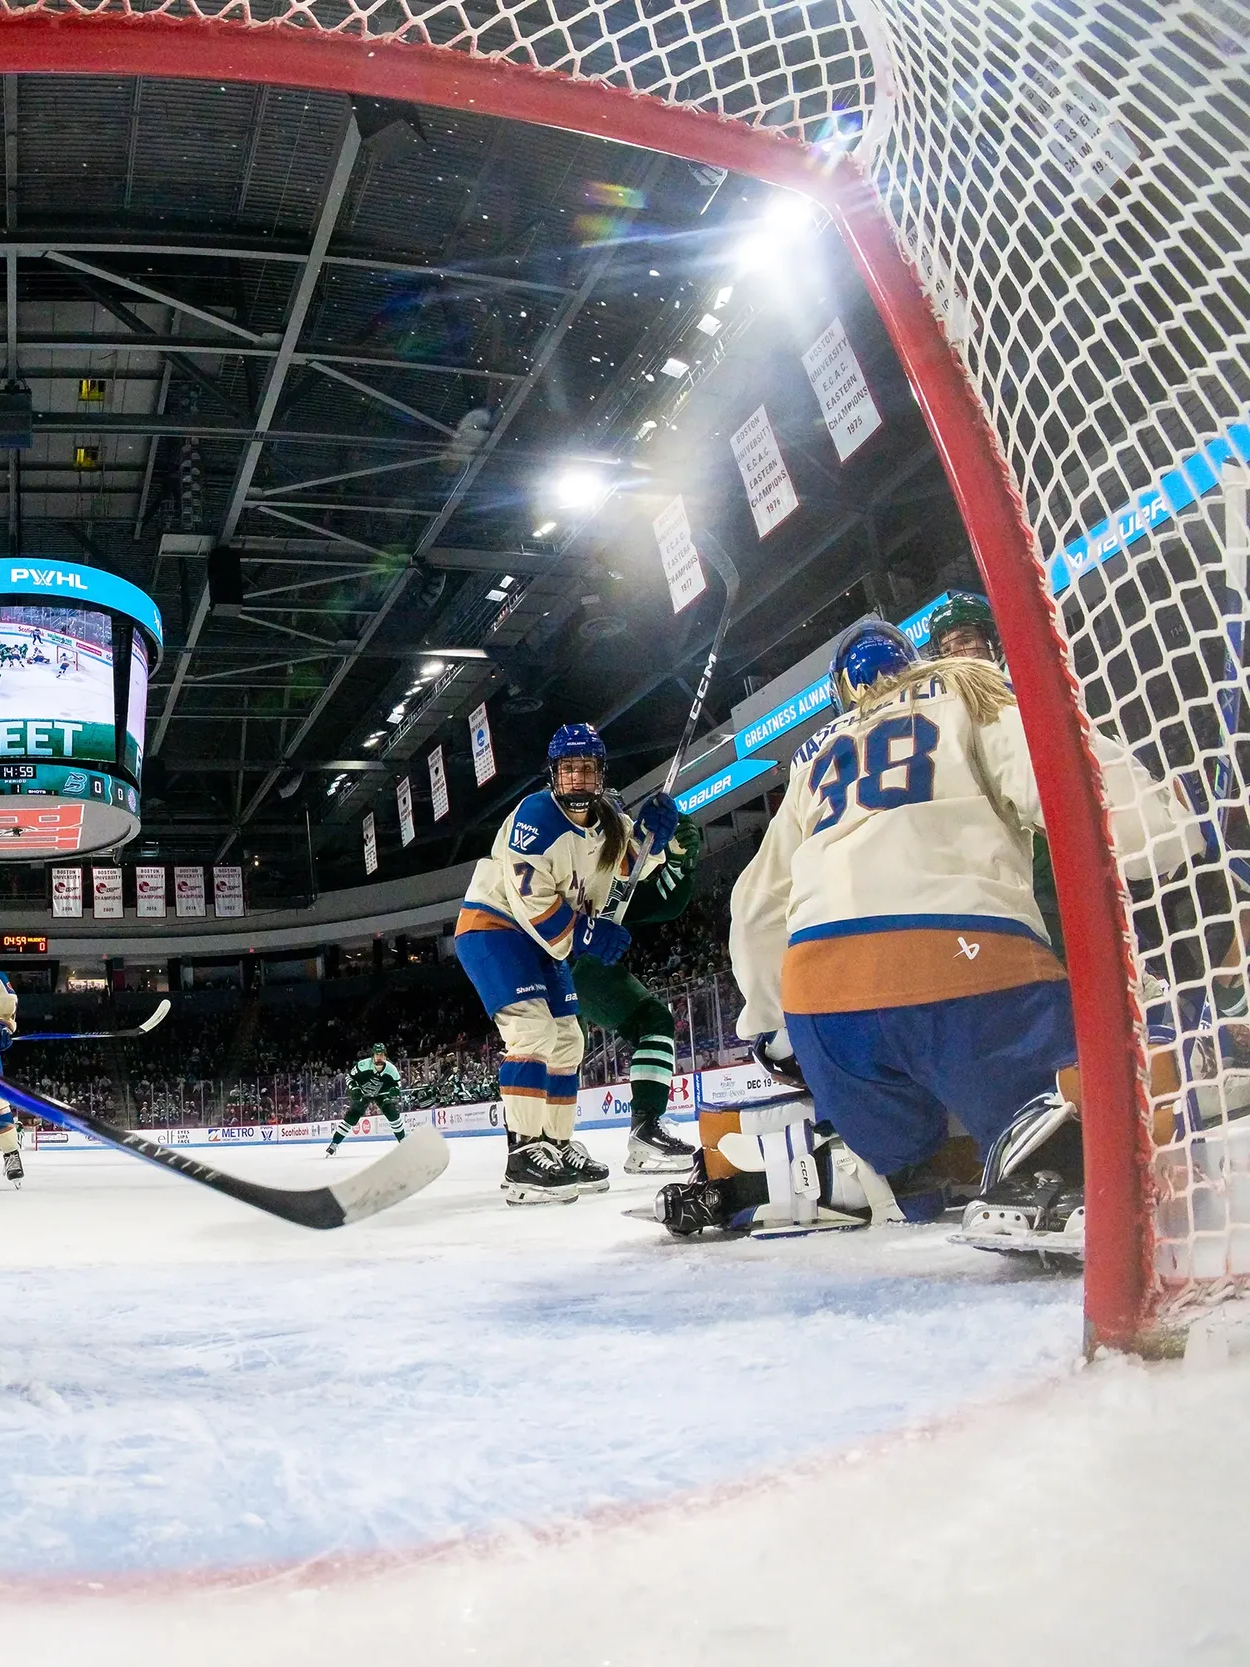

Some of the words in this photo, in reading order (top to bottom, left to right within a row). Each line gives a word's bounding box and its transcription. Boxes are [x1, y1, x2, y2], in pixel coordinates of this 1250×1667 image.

[810, 336, 849, 383] UNIVERSITY
[825, 373, 858, 411] EASTERN
[828, 385, 869, 431] CHAMPIONS
[735, 415, 760, 445] BOSTON
[846, 416, 863, 436] 1975
[736, 425, 771, 463] UNIVERSITY
[749, 458, 778, 490] EASTERN
[751, 469, 787, 508] CHAMPIONS
[11, 568, 88, 590] PWHL
[690, 653, 717, 721] CCM
[744, 706, 798, 749] GREATNESS
[799, 681, 833, 716] ALWAY
[3, 766, 34, 778] 14:59
[688, 775, 732, 808] BAUER
[516, 821, 540, 836] PWHL
[513, 861, 542, 896] 7
[747, 1080, 761, 1089] DEC
[764, 1079, 772, 1087] 19
[157, 1130, 175, 1144] elf
[222, 1127, 254, 1138] METRO
[281, 1128, 309, 1137] Scotiabank
[800, 1161, 810, 1187] CCM
